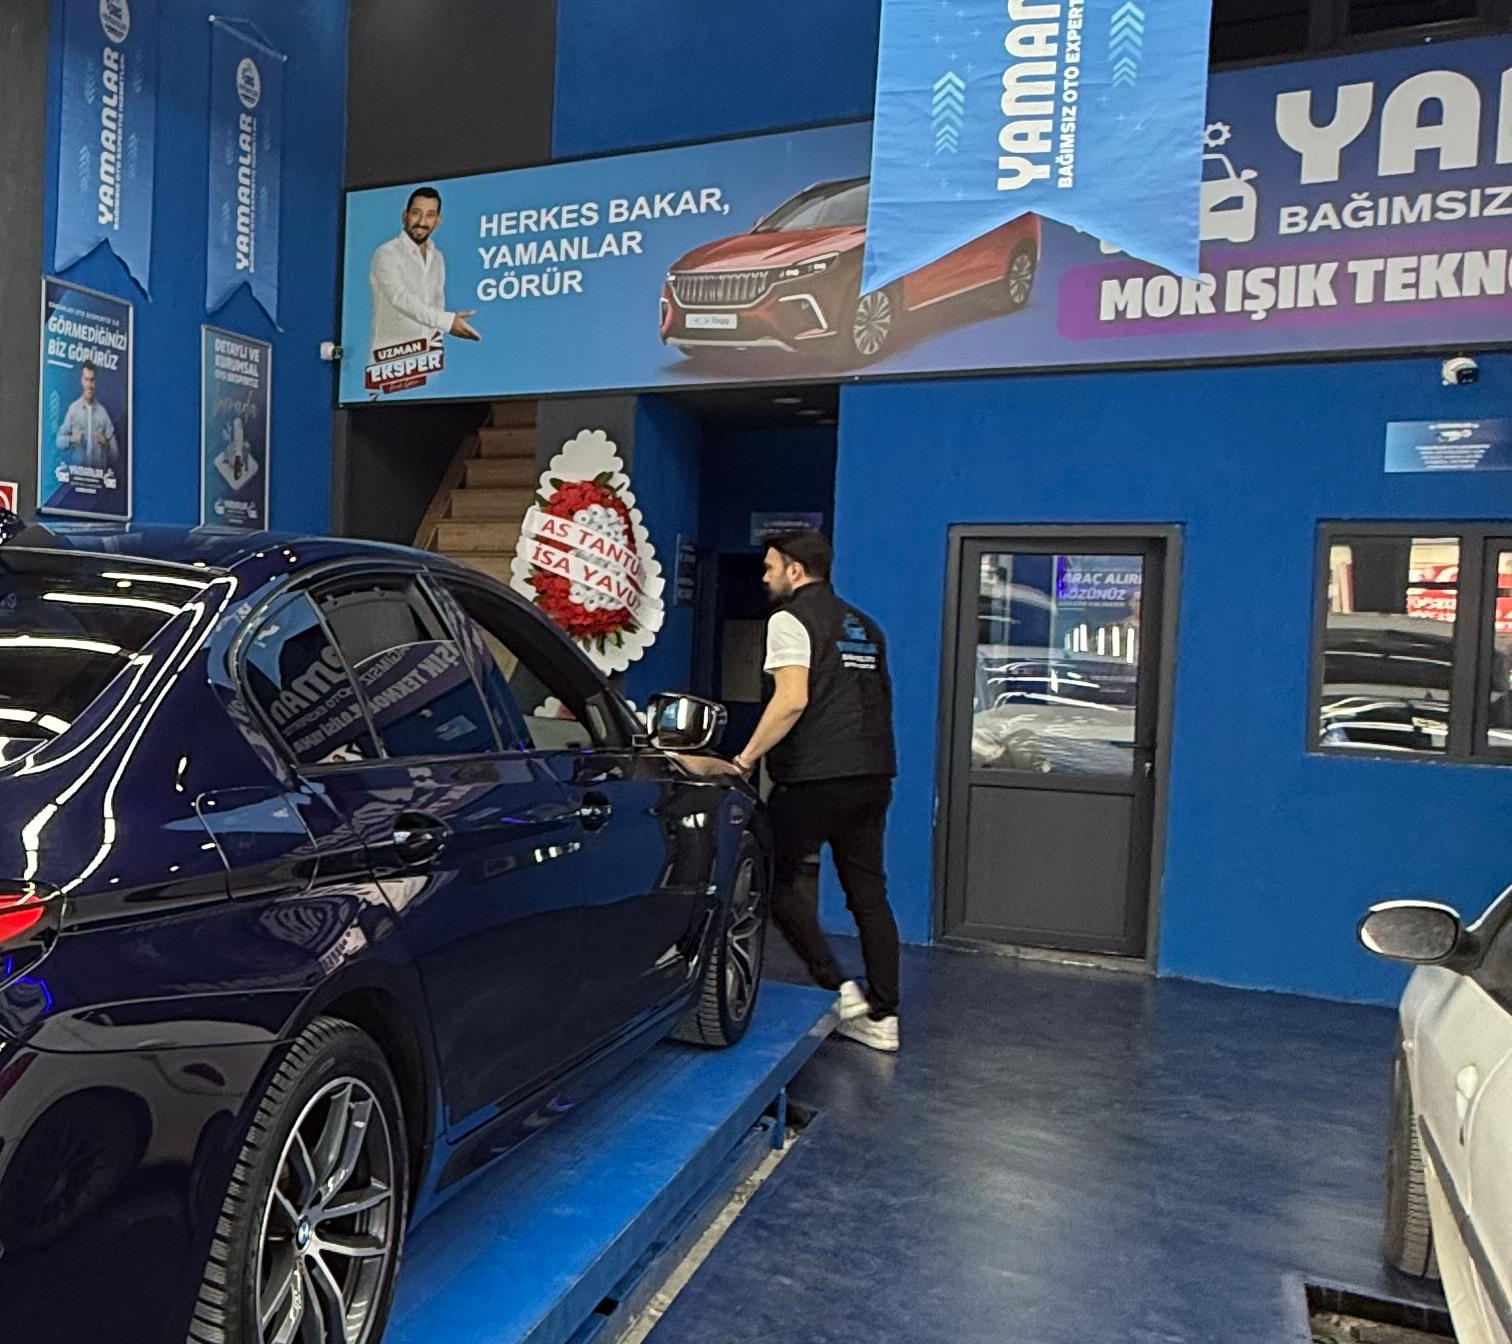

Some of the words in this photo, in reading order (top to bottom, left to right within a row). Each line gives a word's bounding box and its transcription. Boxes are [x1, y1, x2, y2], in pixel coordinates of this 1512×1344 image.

[1062, 66, 1080, 103] OTO
[98, 47, 120, 225] YAMANLAR
[1055, 106, 1077, 188] BAĞIMSIZ
[1275, 70, 1512, 185] YA
[236, 113, 252, 270] YAMANLAR
[480, 202, 600, 238] HERKES
[609, 187, 731, 224] BAKAR,
[1279, 187, 1512, 234] BAĞIMSIZ
[478, 230, 642, 270] YAMANLAR
[476, 269, 583, 302] GÖRÜR
[1100, 274, 1216, 321] MOR
[1225, 262, 1338, 320] IŞIK
[1348, 249, 1512, 305] TEKN
[48, 337, 67, 358] BİZ
[367, 350, 443, 383] EKSPER
[378, 342, 422, 360] UZMAN
[532, 543, 570, 574] İSA
[541, 519, 571, 538] AS
[579, 529, 642, 576] TANTU
